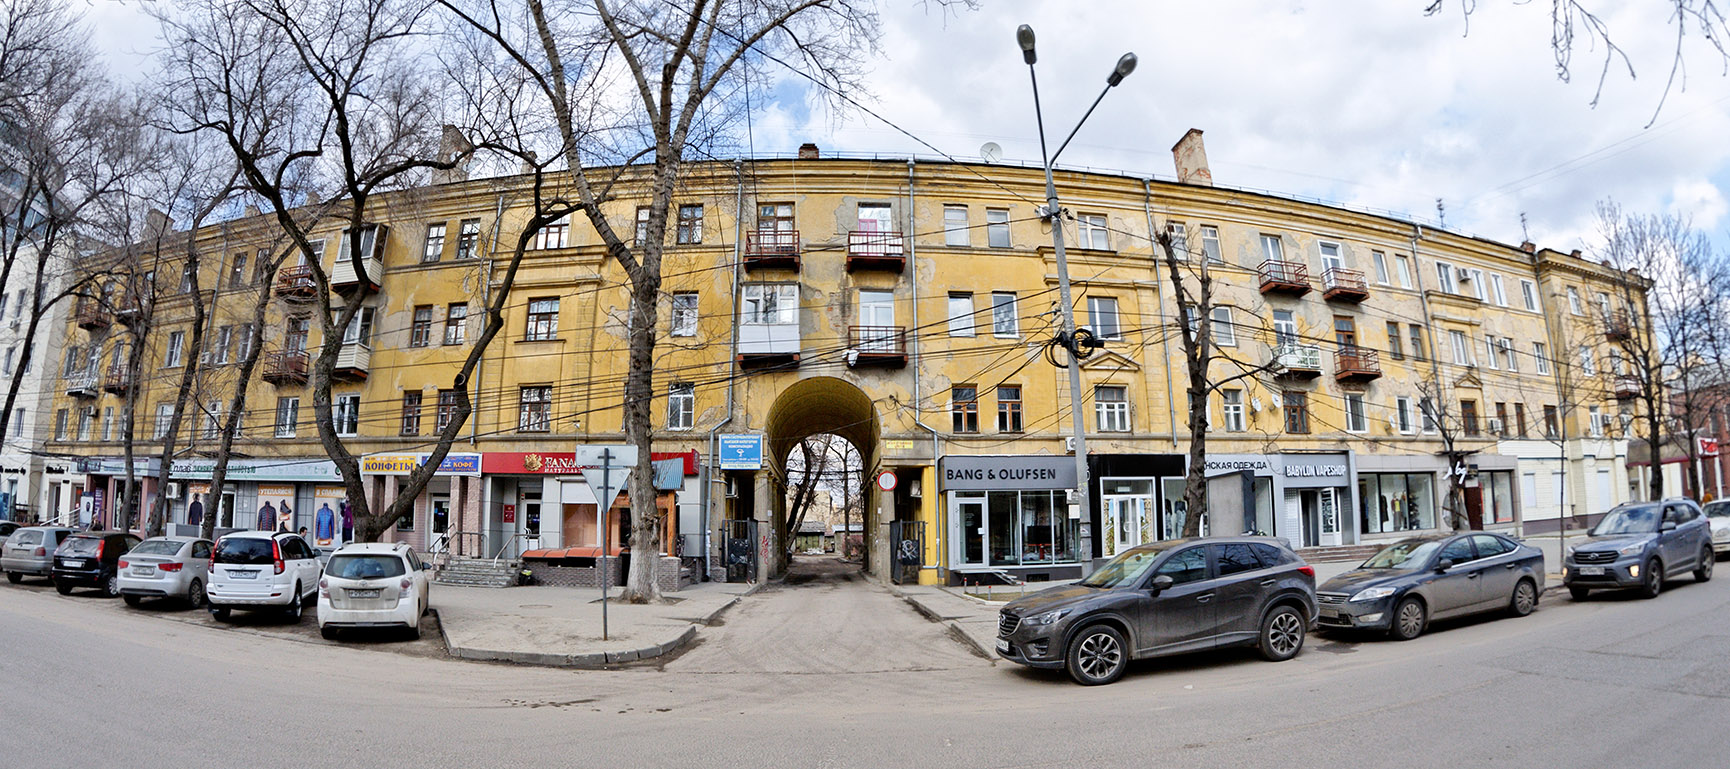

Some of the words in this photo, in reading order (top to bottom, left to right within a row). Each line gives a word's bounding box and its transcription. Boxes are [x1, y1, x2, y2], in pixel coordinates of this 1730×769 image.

[365, 462, 414, 471] КОНФЕТЫ
[1204, 461, 1232, 470] НСКАЯ
[1233, 461, 1267, 470] ОДЕЖДА
[946, 469, 983, 480] BANG
[988, 469, 996, 480] &
[999, 468, 1056, 480] OLUFSEN
[1285, 465, 1315, 478] BABYLON
[1315, 465, 1346, 477] VAPESHOP
